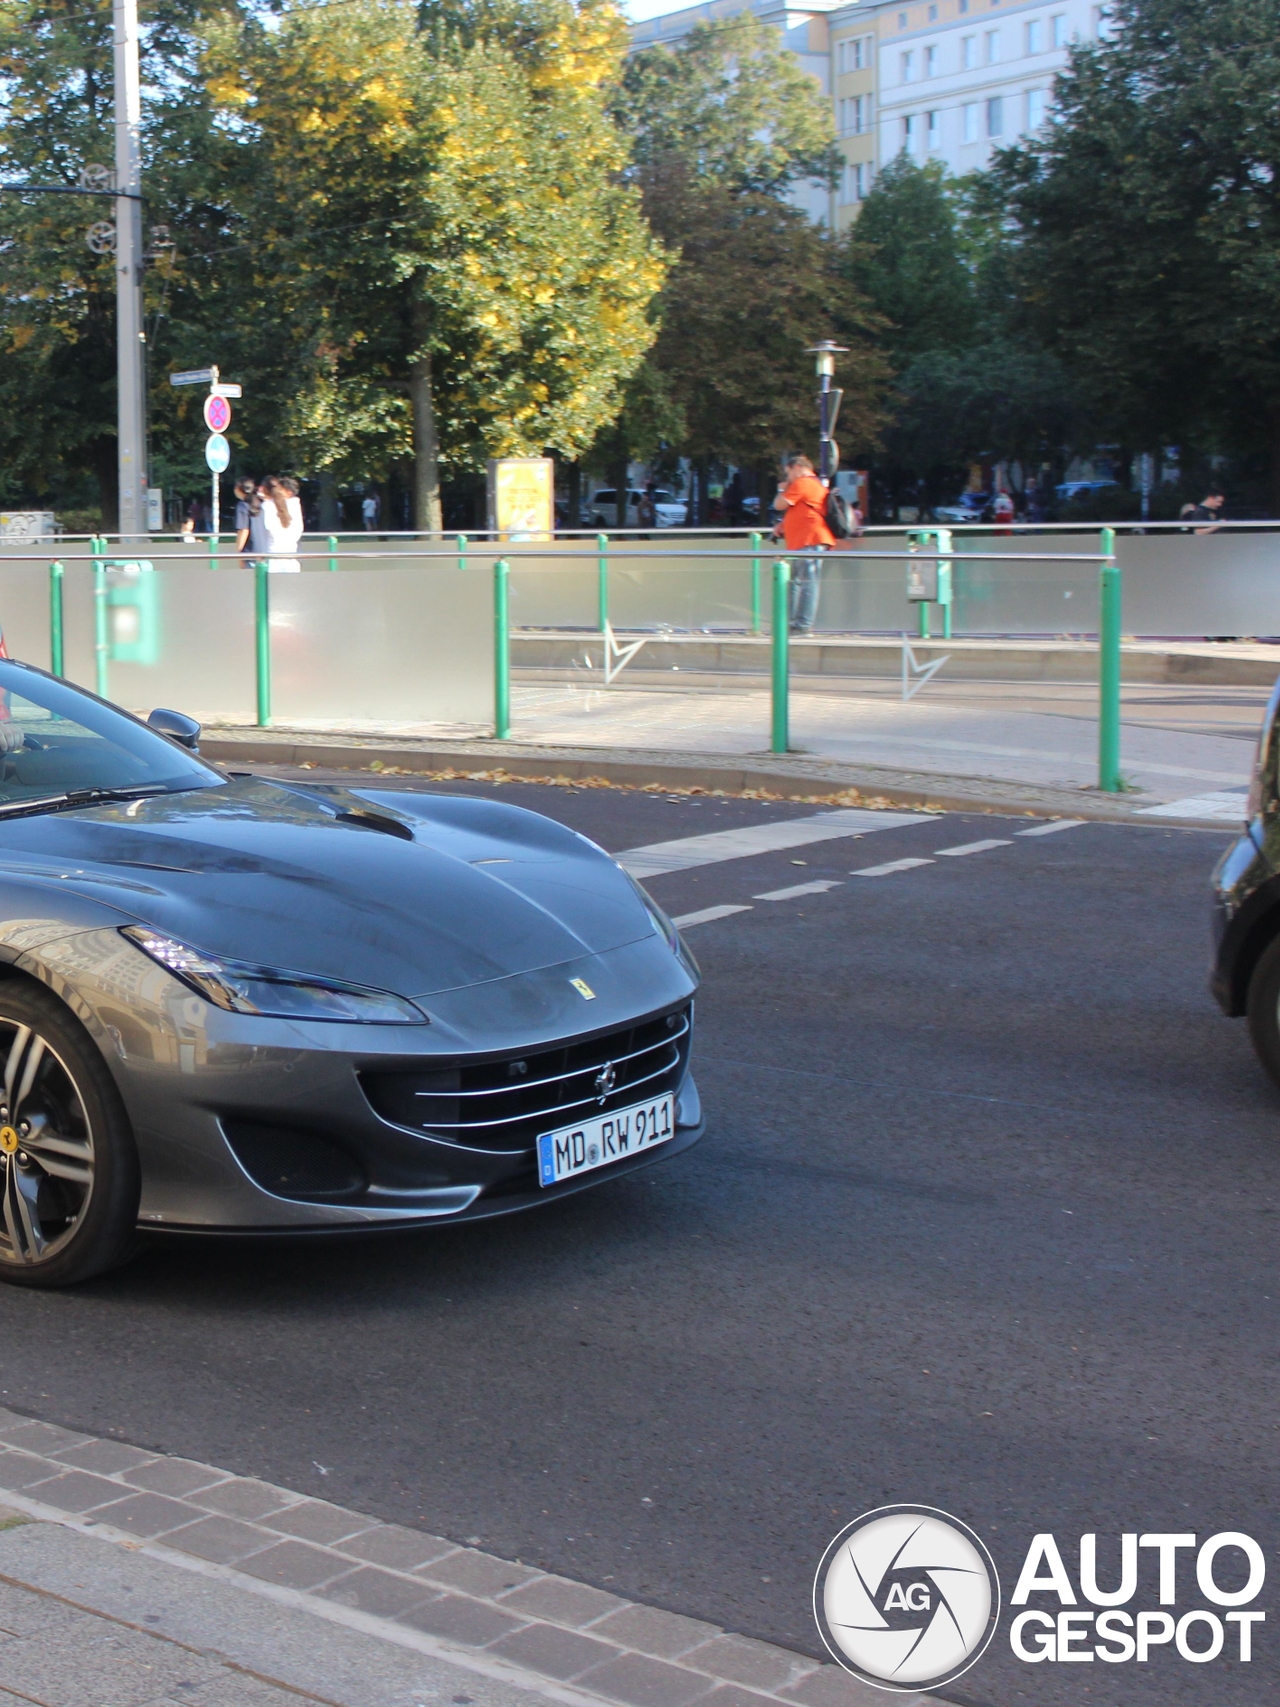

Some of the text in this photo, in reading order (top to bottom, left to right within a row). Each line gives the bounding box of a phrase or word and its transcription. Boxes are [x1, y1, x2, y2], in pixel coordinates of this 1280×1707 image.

[554, 1131, 586, 1174] MD
[601, 1115, 630, 1158] RW
[635, 1100, 672, 1146] 911
